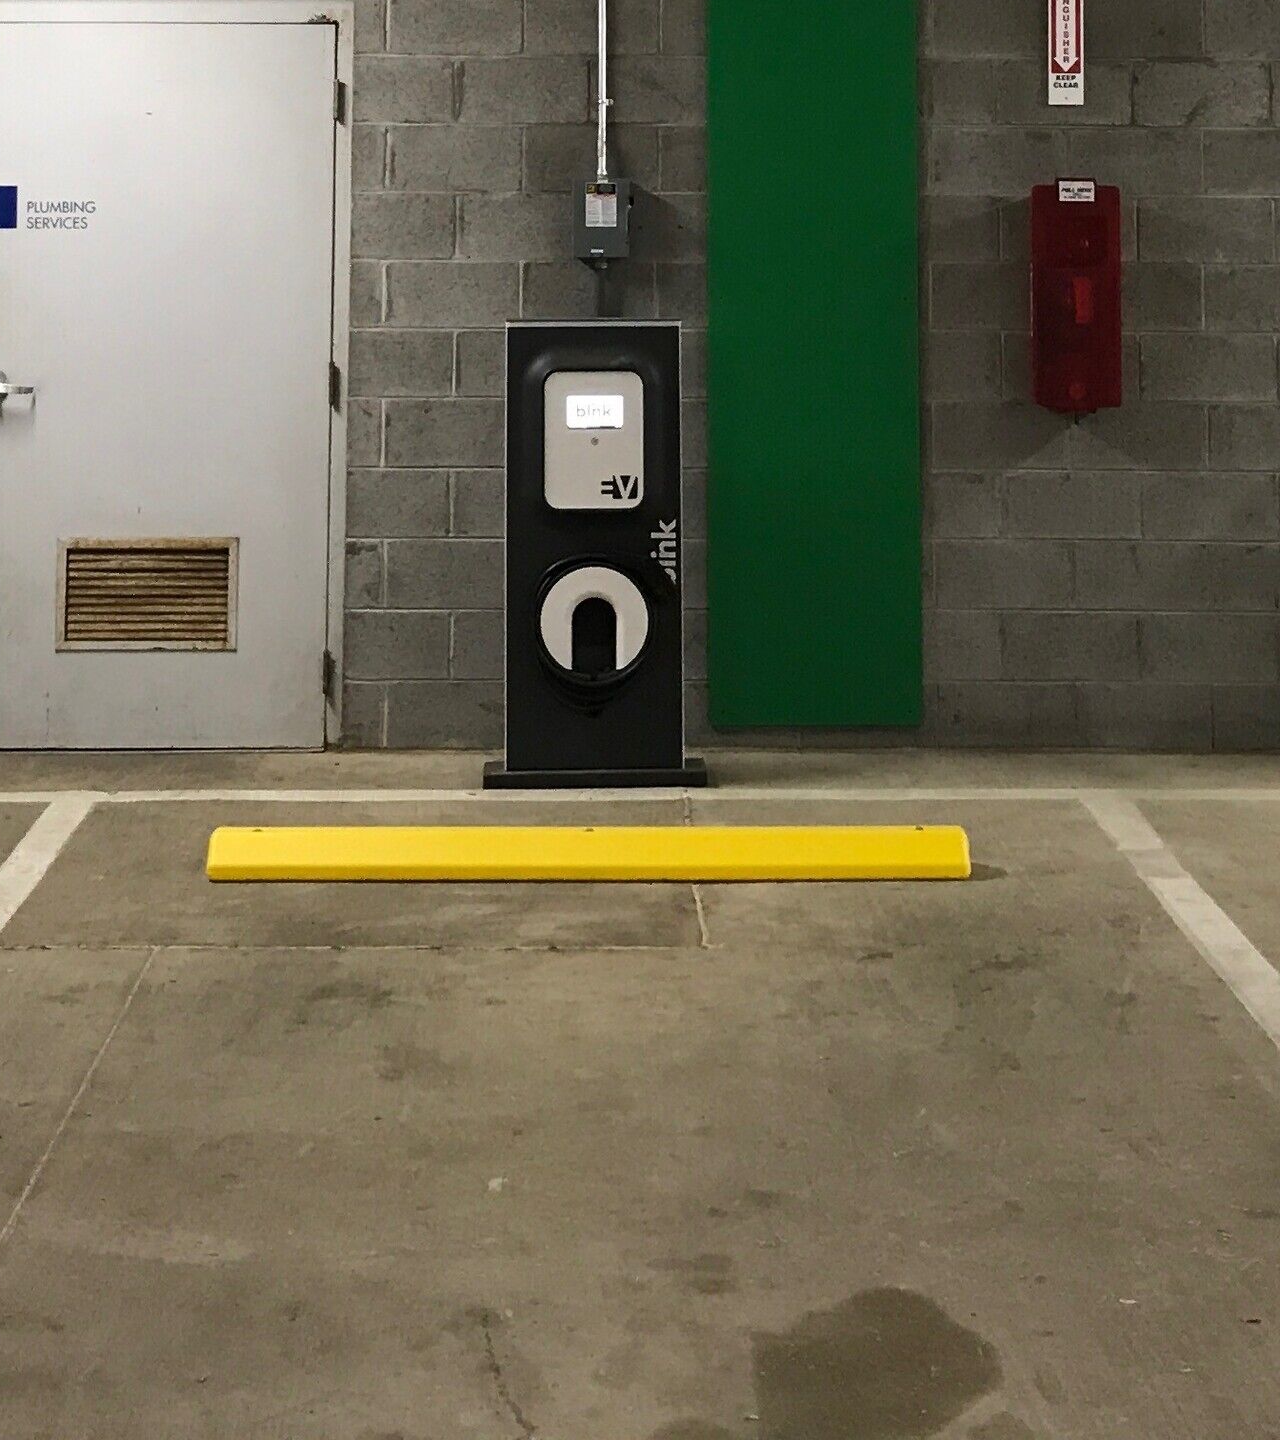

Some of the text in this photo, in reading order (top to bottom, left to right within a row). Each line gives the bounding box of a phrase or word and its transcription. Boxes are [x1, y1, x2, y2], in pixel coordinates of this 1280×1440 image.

[26, 201, 97, 214] PLUMBING
[26, 216, 89, 230] SERVICES
[650, 518, 677, 585] link
